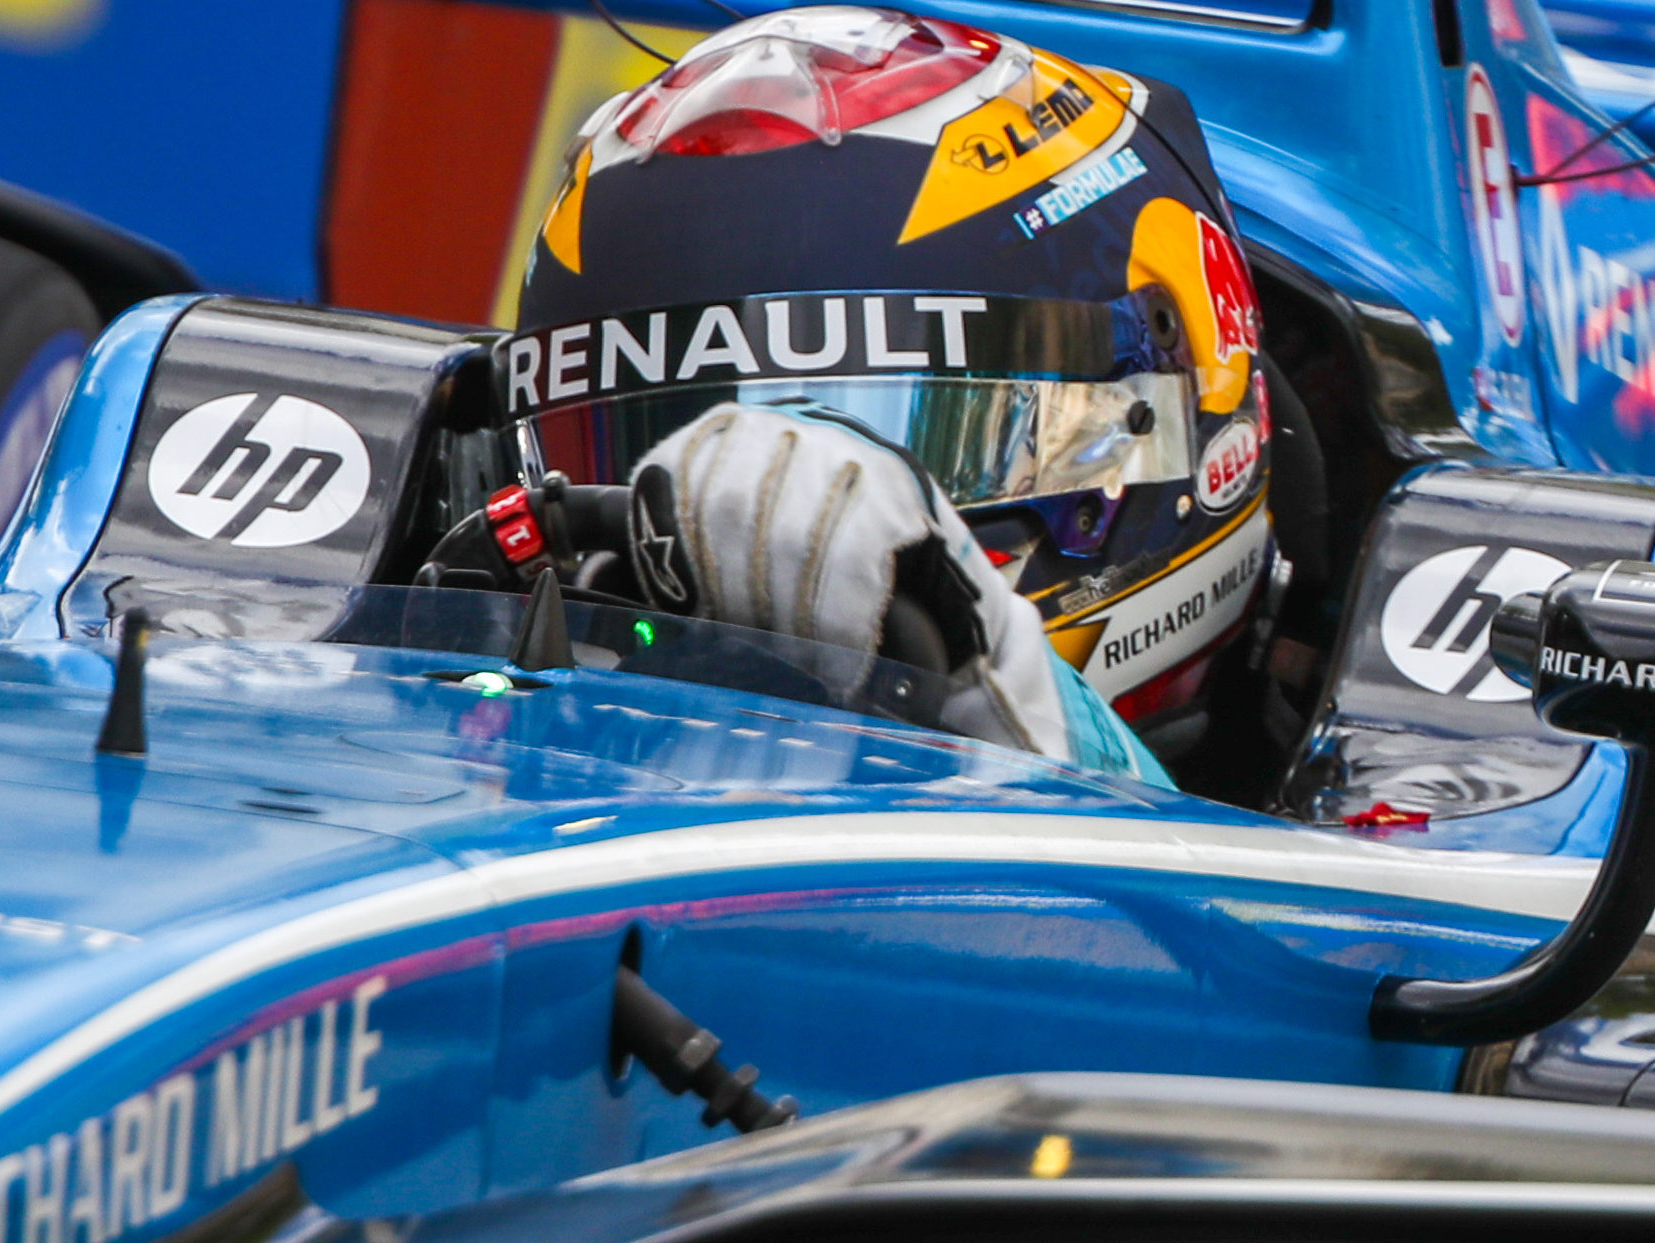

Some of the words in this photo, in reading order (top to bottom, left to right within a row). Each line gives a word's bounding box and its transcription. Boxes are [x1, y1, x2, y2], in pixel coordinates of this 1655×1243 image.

[508, 296, 988, 413] RENAULT
[173, 393, 345, 547] hp
[1206, 433, 1257, 495] BELL
[1103, 590, 1206, 669] RICHARD
[1210, 547, 1259, 604] MILLE
[206, 975, 387, 1188] MILLE
